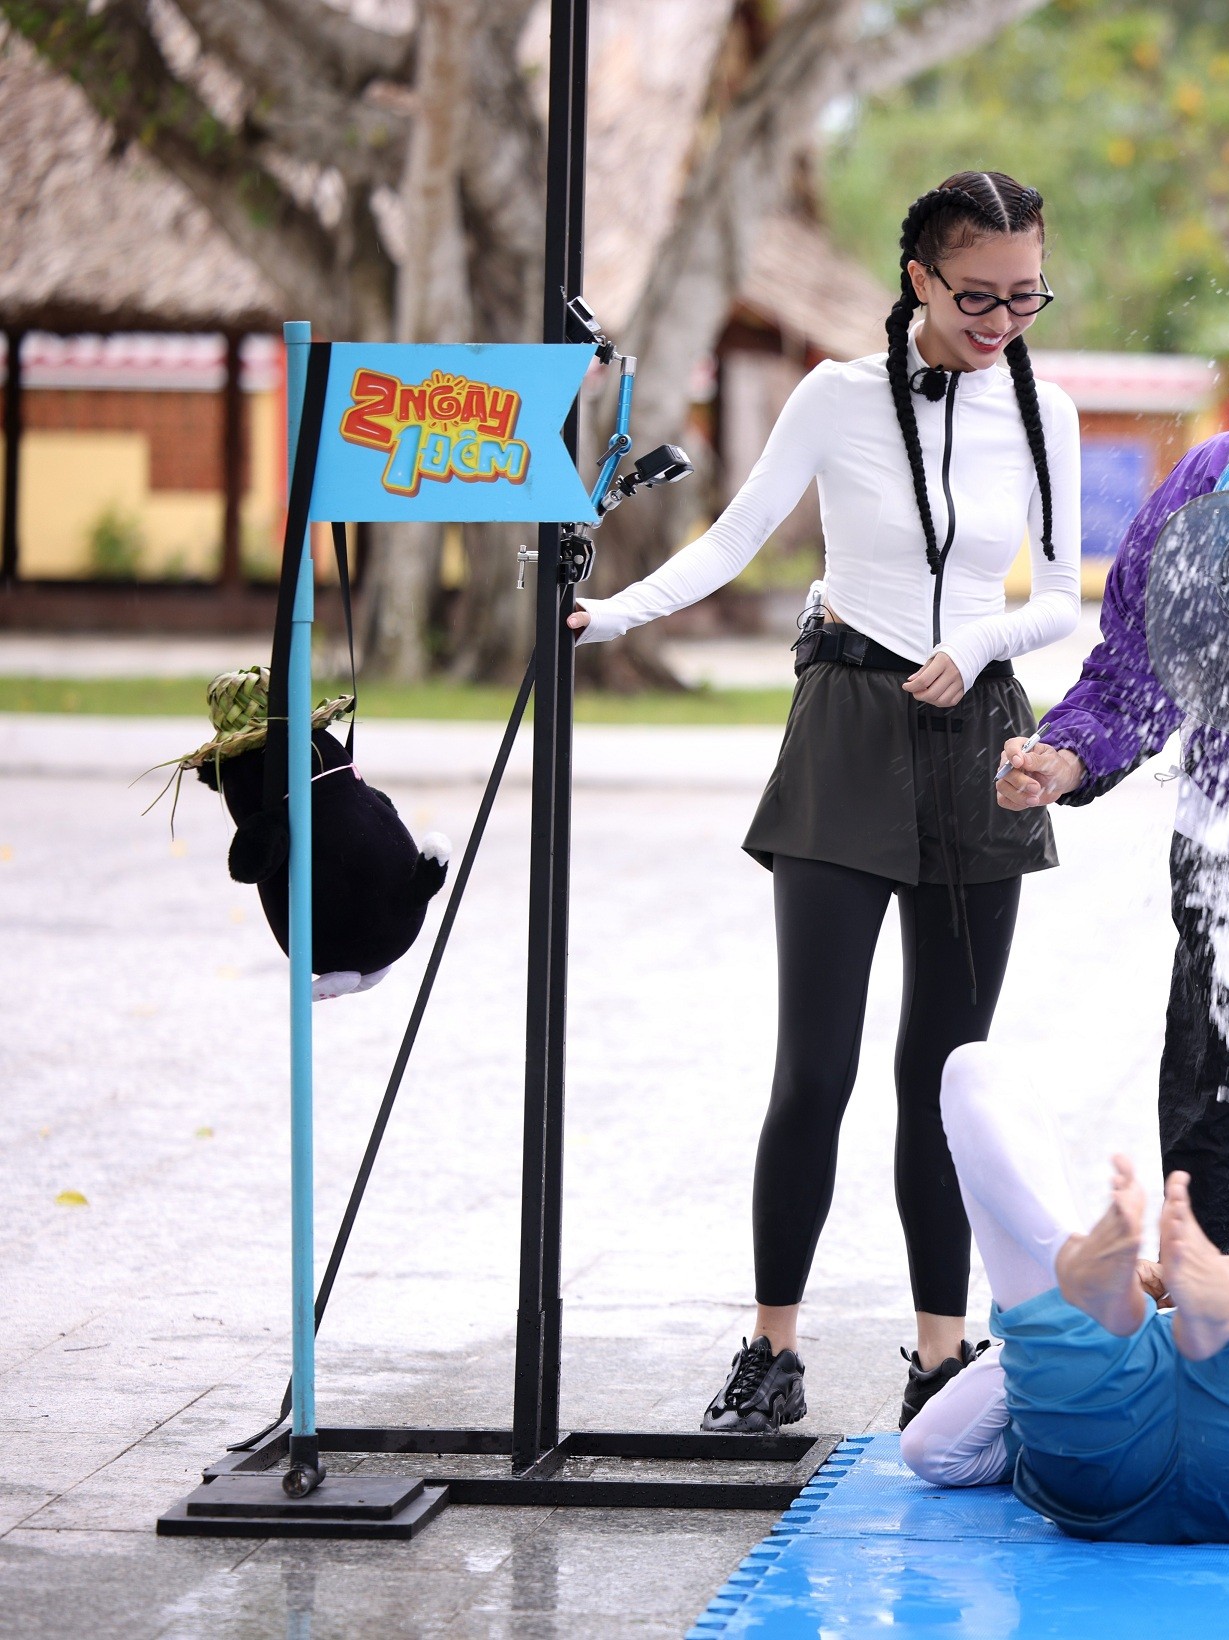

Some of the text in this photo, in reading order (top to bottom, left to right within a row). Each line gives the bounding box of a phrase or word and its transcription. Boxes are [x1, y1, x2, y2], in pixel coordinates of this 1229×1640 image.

[342, 370, 400, 446] 2
[384, 423, 526, 489] 1 ĐÊM
